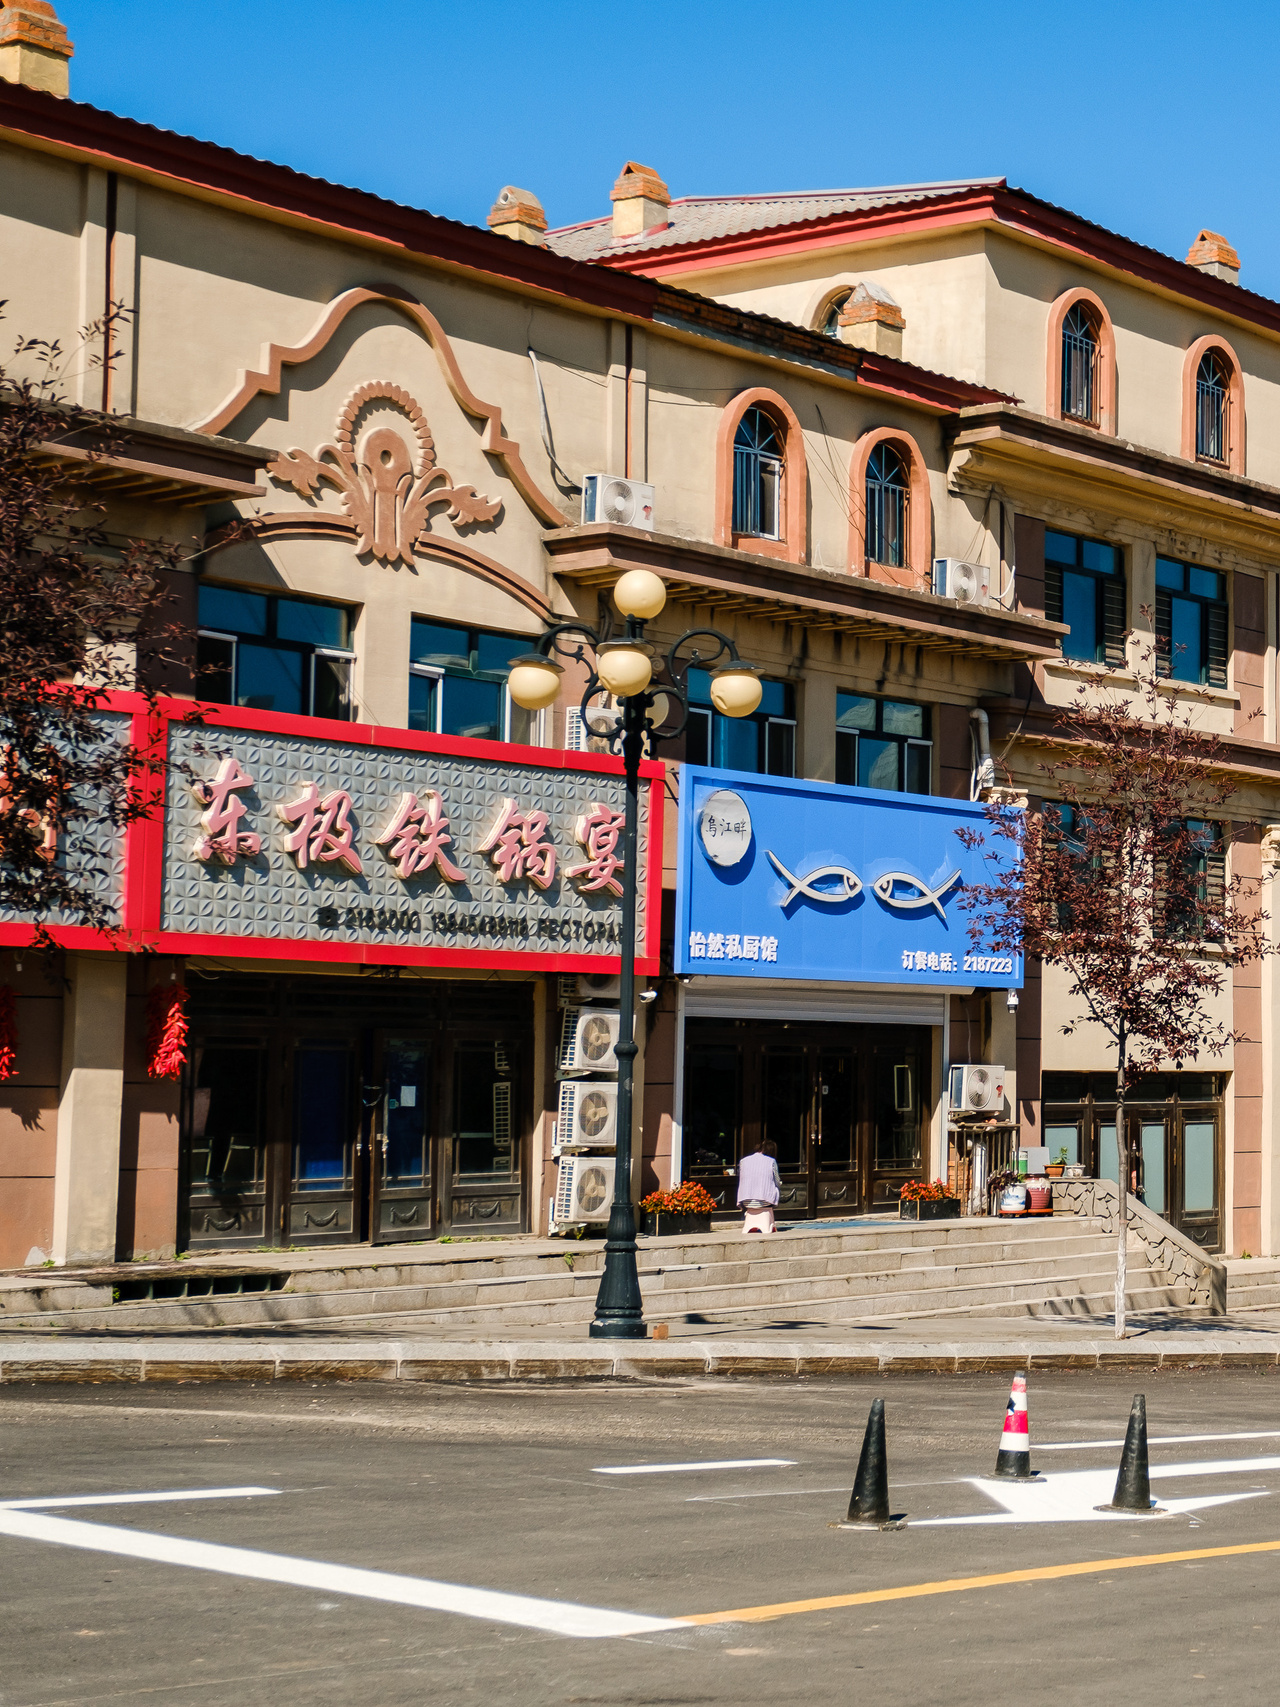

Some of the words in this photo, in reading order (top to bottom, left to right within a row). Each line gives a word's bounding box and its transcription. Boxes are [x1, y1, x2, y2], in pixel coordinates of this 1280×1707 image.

[191, 757, 626, 898] 东极铁锅宴
[689, 931, 779, 962] 怡然私厨馆
